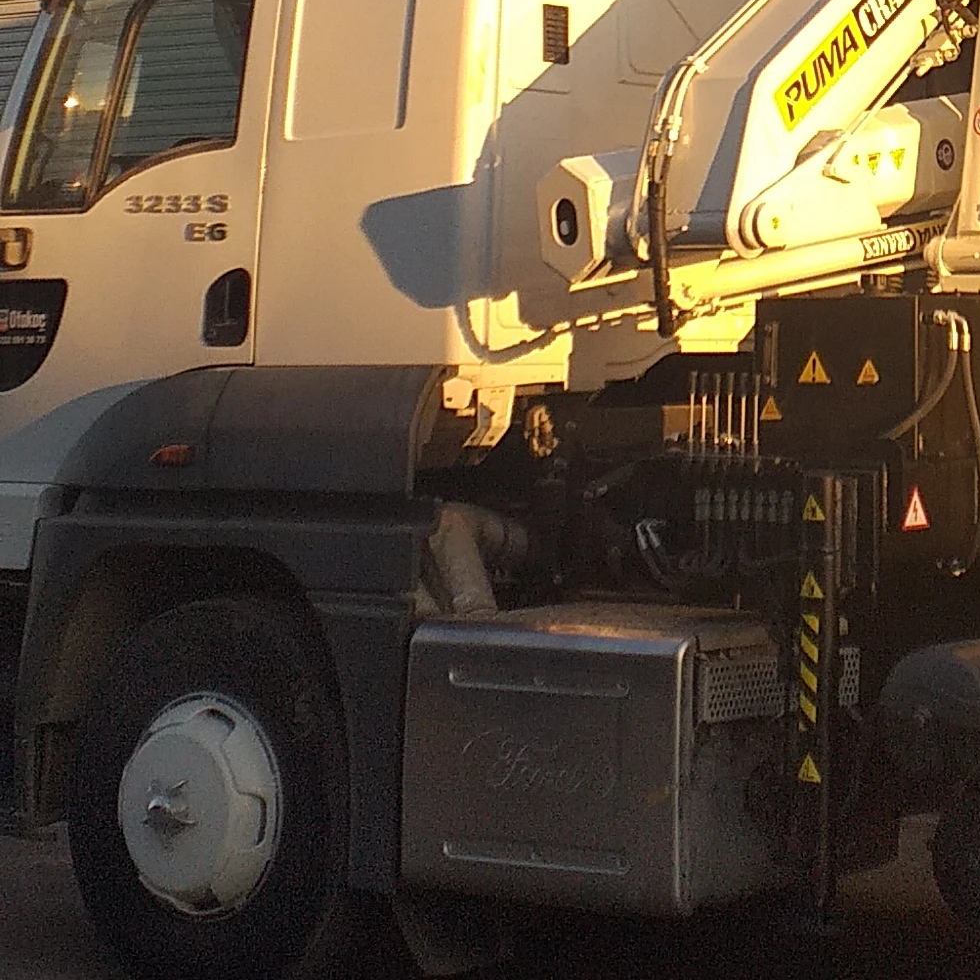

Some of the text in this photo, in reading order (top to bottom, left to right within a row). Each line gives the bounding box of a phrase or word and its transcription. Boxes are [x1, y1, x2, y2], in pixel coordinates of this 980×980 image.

[784, 24, 860, 123] PUMA
[184, 222, 228, 242] E6
[862, 230, 915, 259] CRANES
